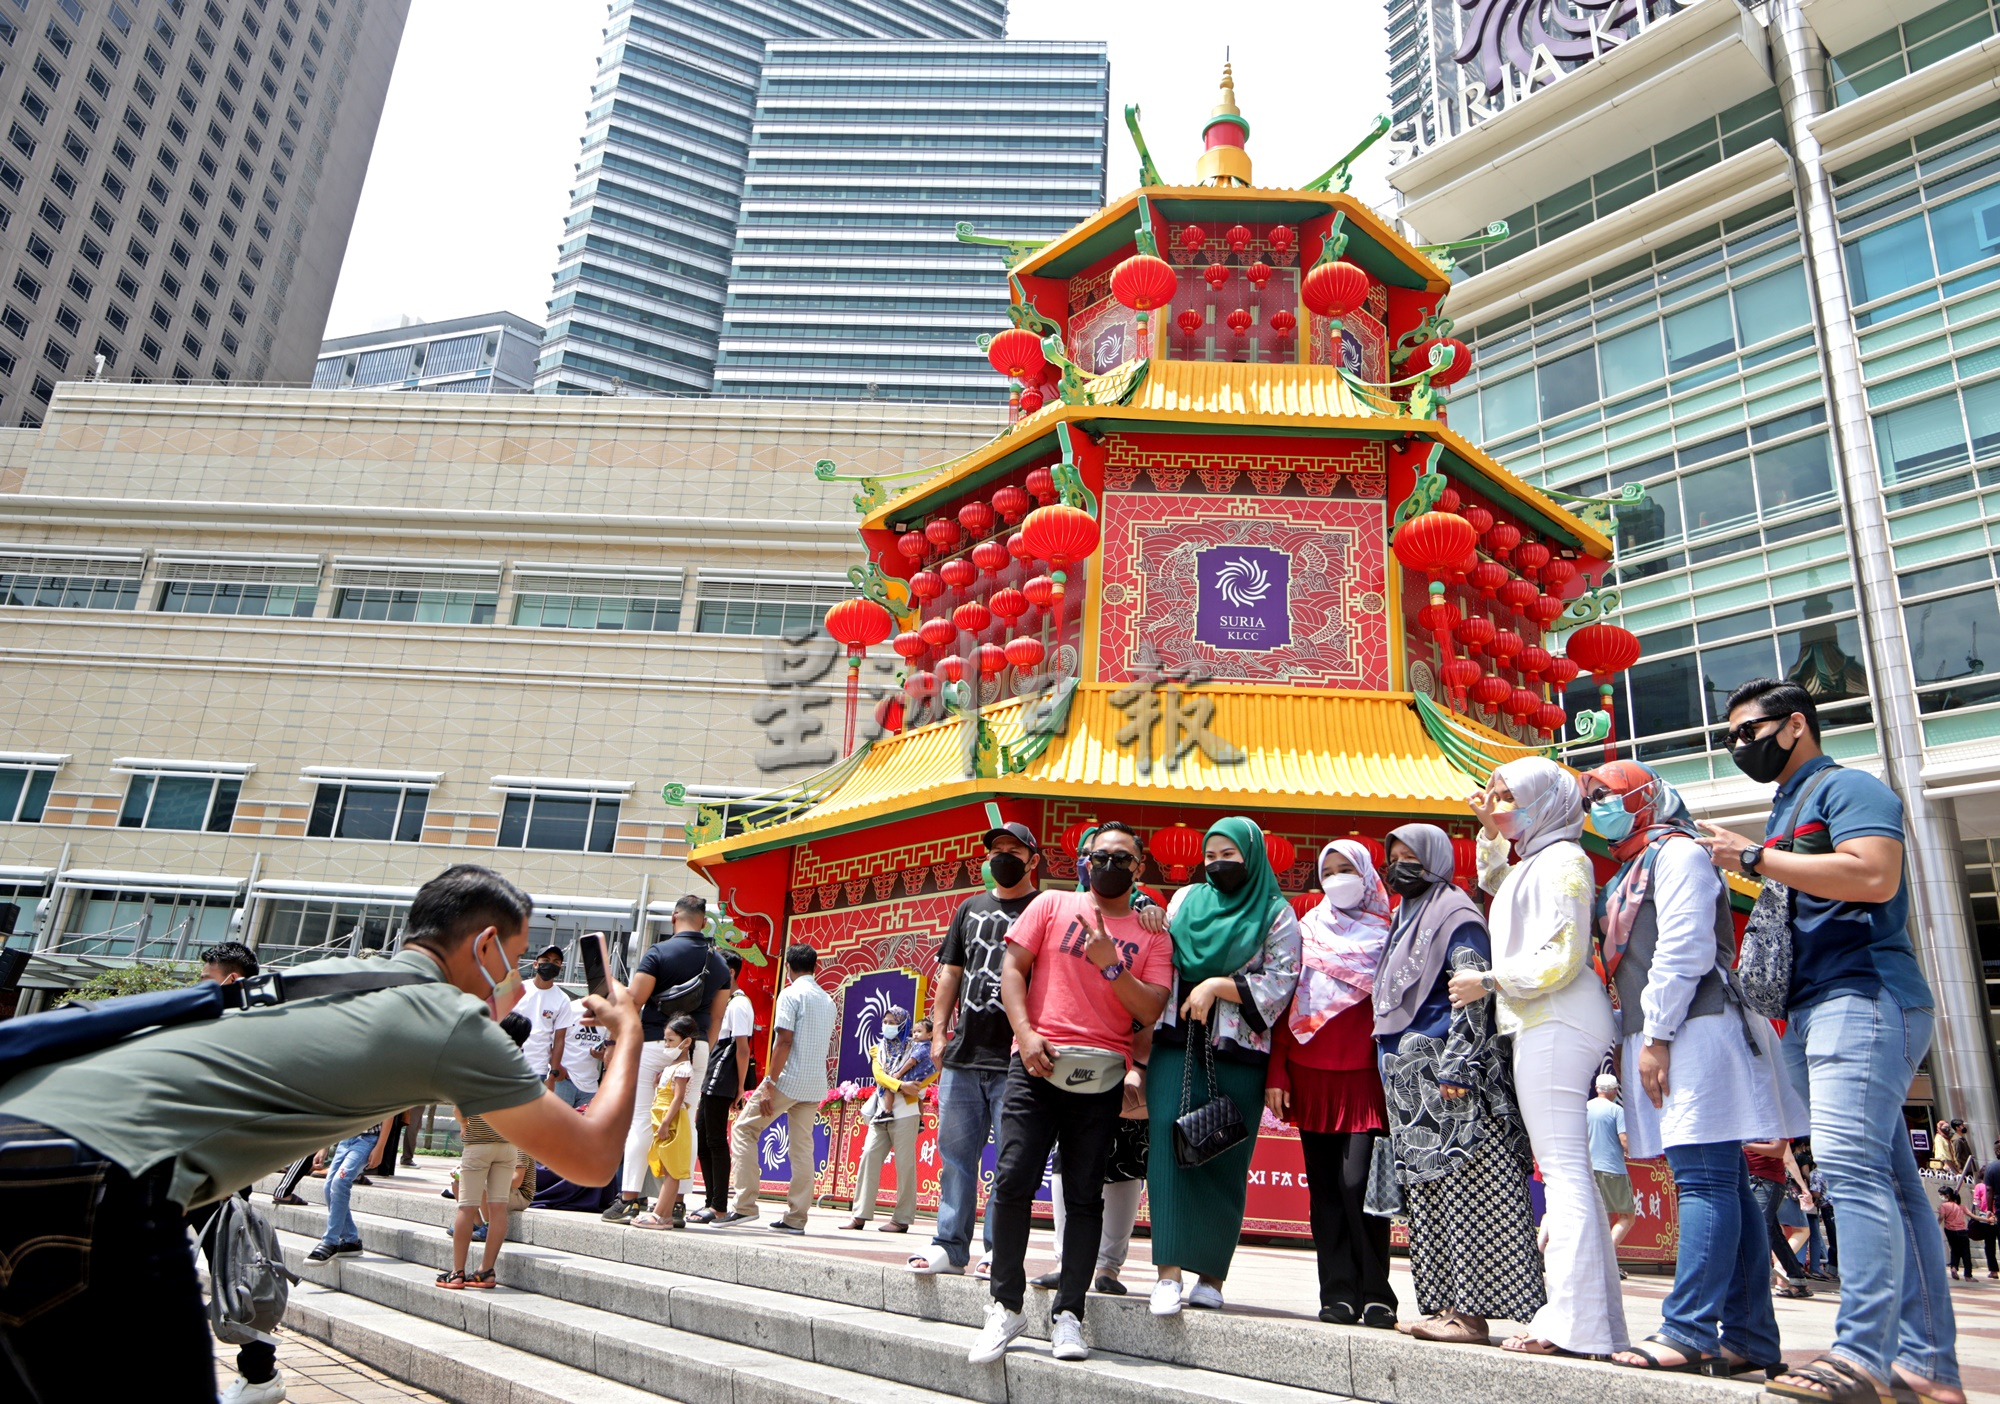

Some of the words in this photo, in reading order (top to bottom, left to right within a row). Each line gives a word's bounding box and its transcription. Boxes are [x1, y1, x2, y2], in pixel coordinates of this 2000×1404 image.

[1384, 42, 1569, 166] SURIA
[1588, 0, 1700, 59] KL
[1219, 615, 1266, 628] SURIA
[1227, 631, 1259, 641] KLCC
[1071, 1067, 1096, 1080] NIKE
[854, 1076, 876, 1089] SUR
[1247, 1169, 1267, 1186] XI
[1271, 1171, 1294, 1188] FA
[1297, 1172, 1310, 1188] C
